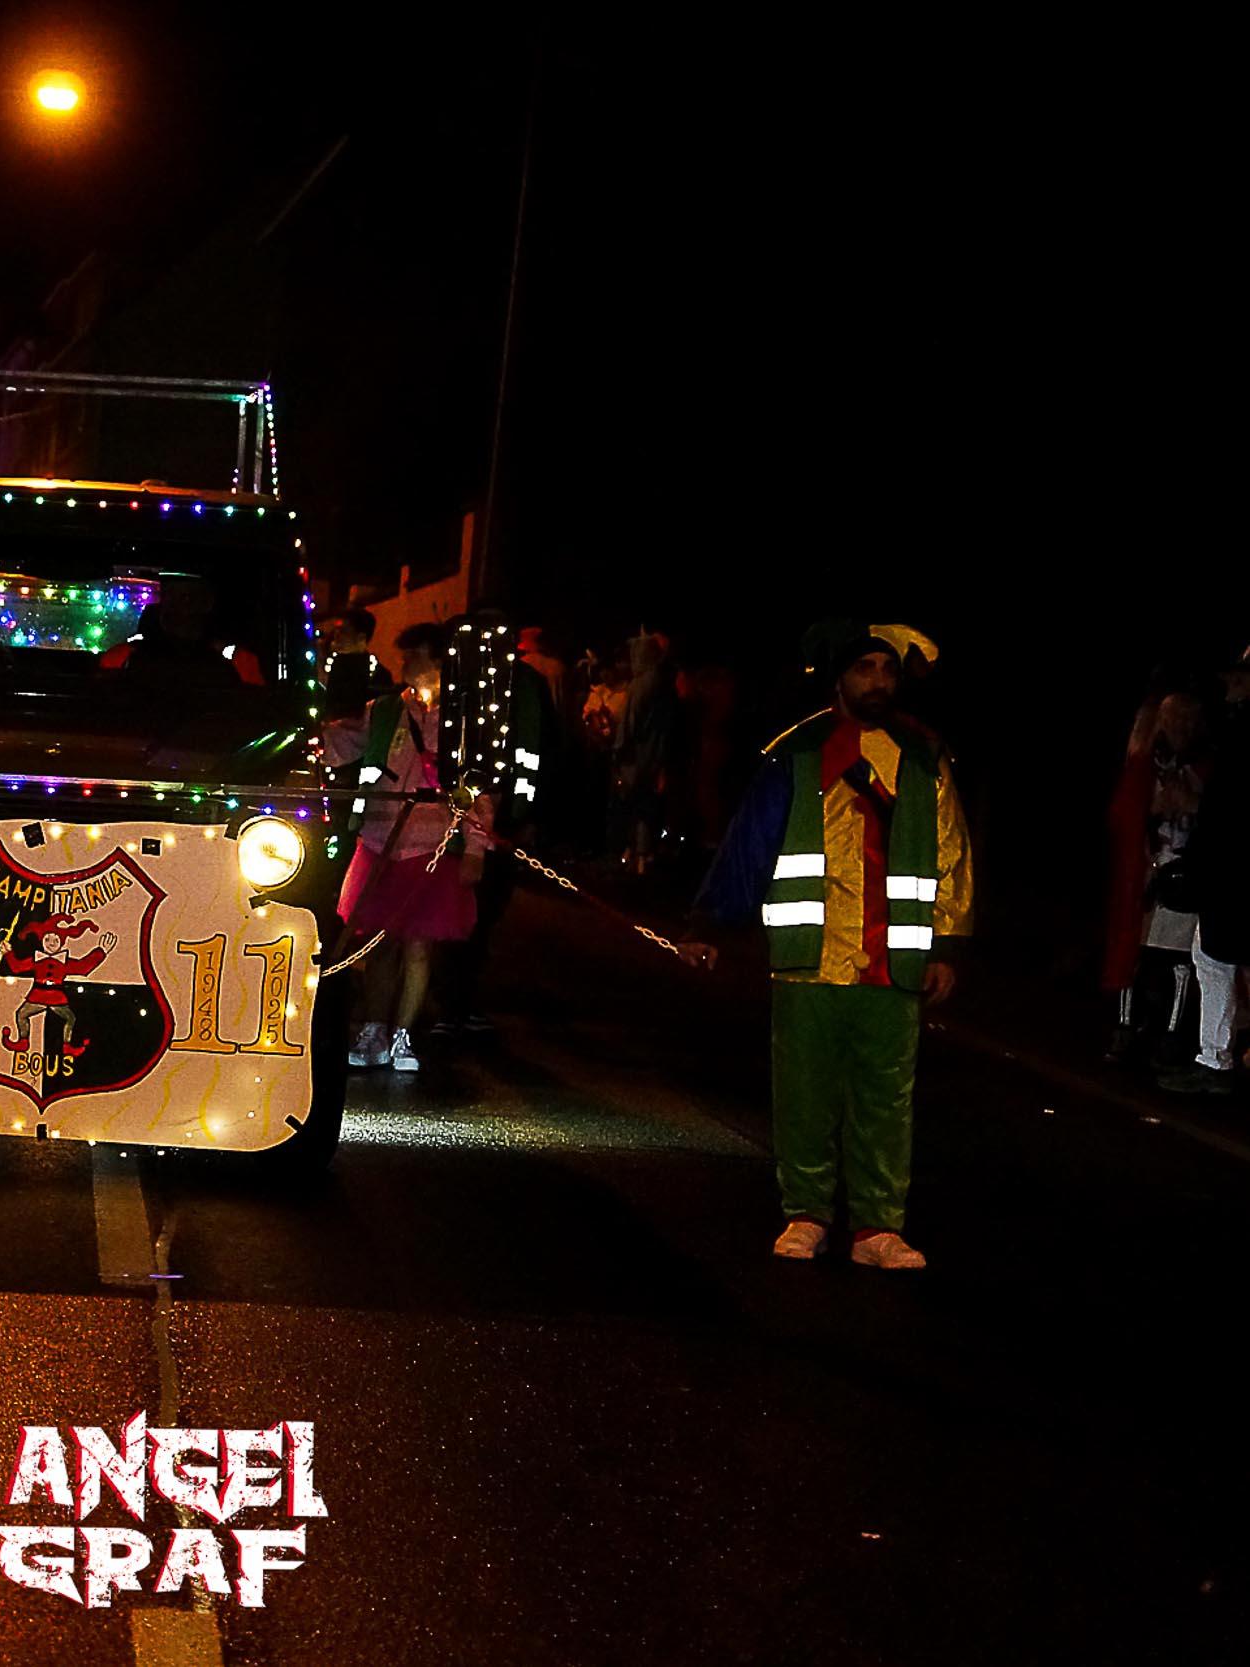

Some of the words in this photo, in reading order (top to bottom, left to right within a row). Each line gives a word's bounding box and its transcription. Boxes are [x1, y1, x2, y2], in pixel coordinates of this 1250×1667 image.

[168, 933, 304, 1056] 11
[197, 951, 216, 1041] 1948
[266, 951, 286, 1044] 2025
[12, 1051, 75, 1077] BOUS
